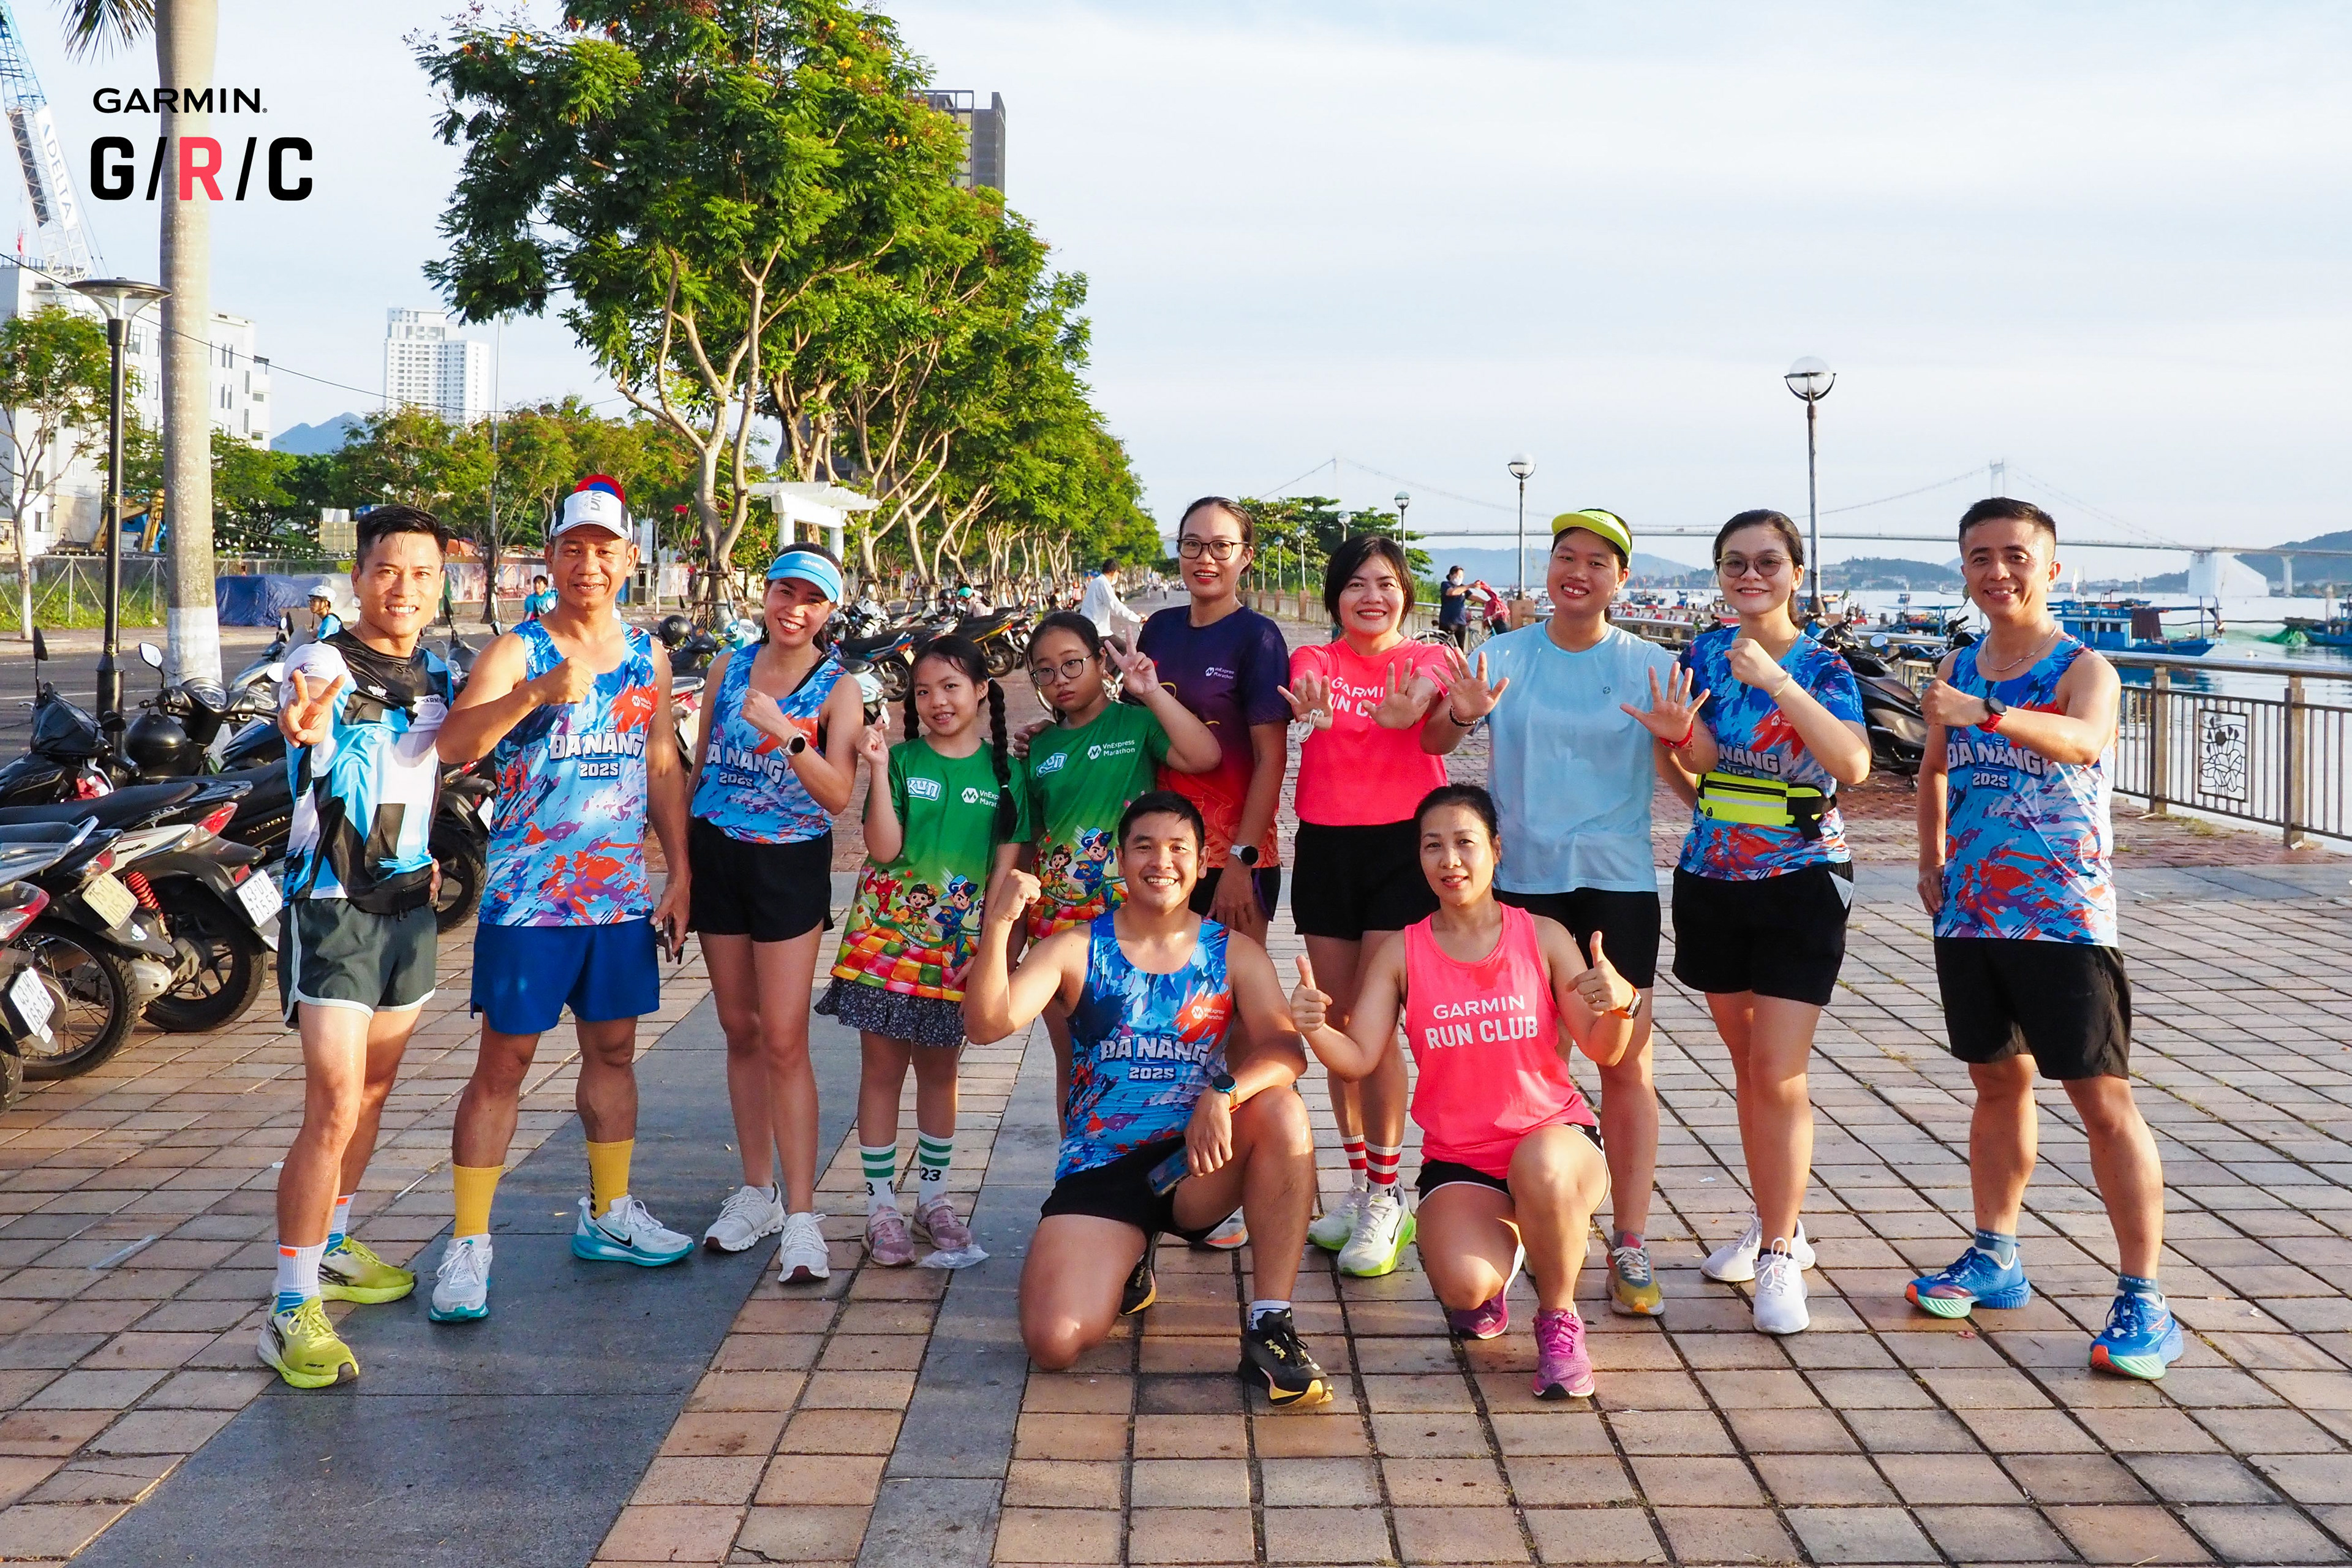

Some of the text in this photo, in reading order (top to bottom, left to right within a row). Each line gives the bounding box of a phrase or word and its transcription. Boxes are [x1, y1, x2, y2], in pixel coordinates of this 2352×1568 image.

[47, 139, 71, 219] DELTA
[1332, 677, 1384, 698] GARMI
[706, 739, 722, 764] À
[1102, 740, 1135, 749] VnExpress
[1103, 747, 1136, 756] Marathon
[579, 763, 619, 777] 2025
[718, 772, 753, 788] 2025
[1972, 772, 2008, 788] 2025
[979, 790, 999, 801] VnExp
[979, 799, 997, 809] Marat
[1433, 995, 1525, 1019] GARMIN
[1425, 1016, 1538, 1049] RUN CLUB
[1128, 1066, 1174, 1079] 2025
